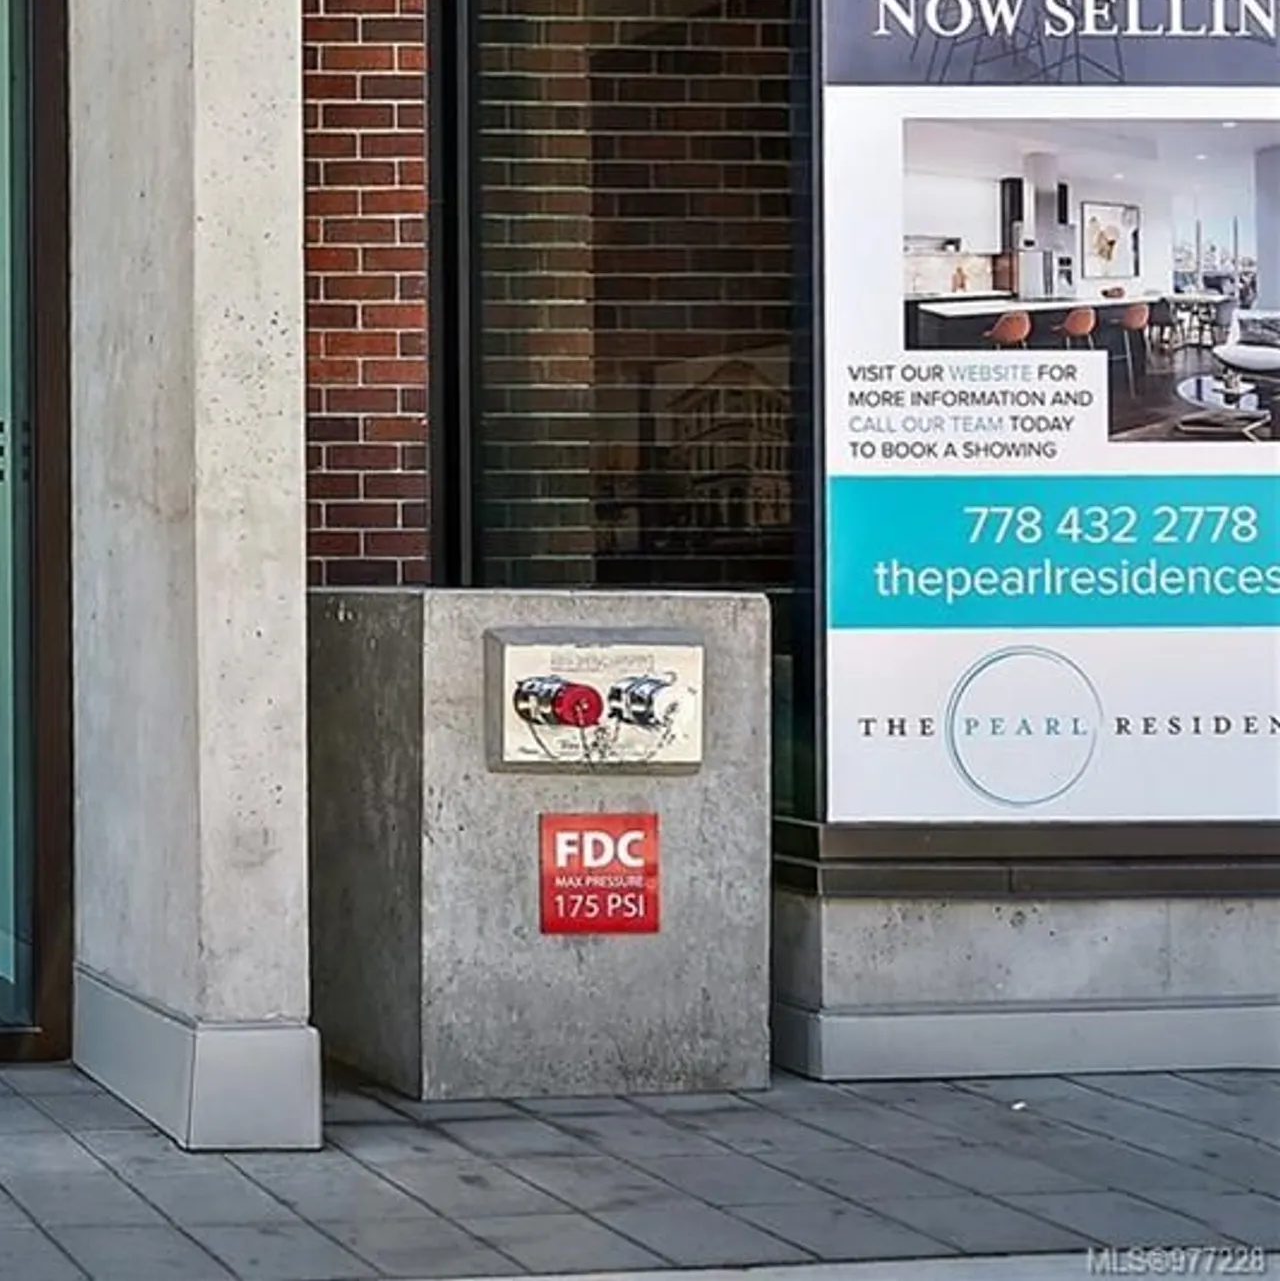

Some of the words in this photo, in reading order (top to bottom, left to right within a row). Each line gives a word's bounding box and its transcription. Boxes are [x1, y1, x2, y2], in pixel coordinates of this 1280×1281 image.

[847, 364, 896, 382] VISIT
[900, 364, 944, 382] OUR
[948, 364, 1032, 382] WEBSITE
[1037, 364, 1078, 382] FOR
[848, 390, 906, 408] MORE
[910, 390, 1046, 407] INFORMATION
[1050, 390, 1093, 407] AND
[848, 416, 897, 433] CALL
[901, 416, 945, 433] OUR
[950, 416, 1003, 433] TEAM
[1009, 415, 1075, 433] TODAY
[848, 441, 876, 459] TO
[881, 441, 938, 459] BOOK
[943, 442, 958, 458] A
[962, 441, 1058, 459] SHOWING
[964, 506, 1043, 544] 778
[1056, 506, 1138, 544] 432
[1152, 506, 1259, 544] 2778
[858, 718, 937, 736] THE
[964, 718, 1089, 736] PEARL
[555, 830, 645, 868] FDC
[555, 876, 583, 888] MAX
[555, 894, 600, 918] 175
[607, 893, 645, 918] PSI
